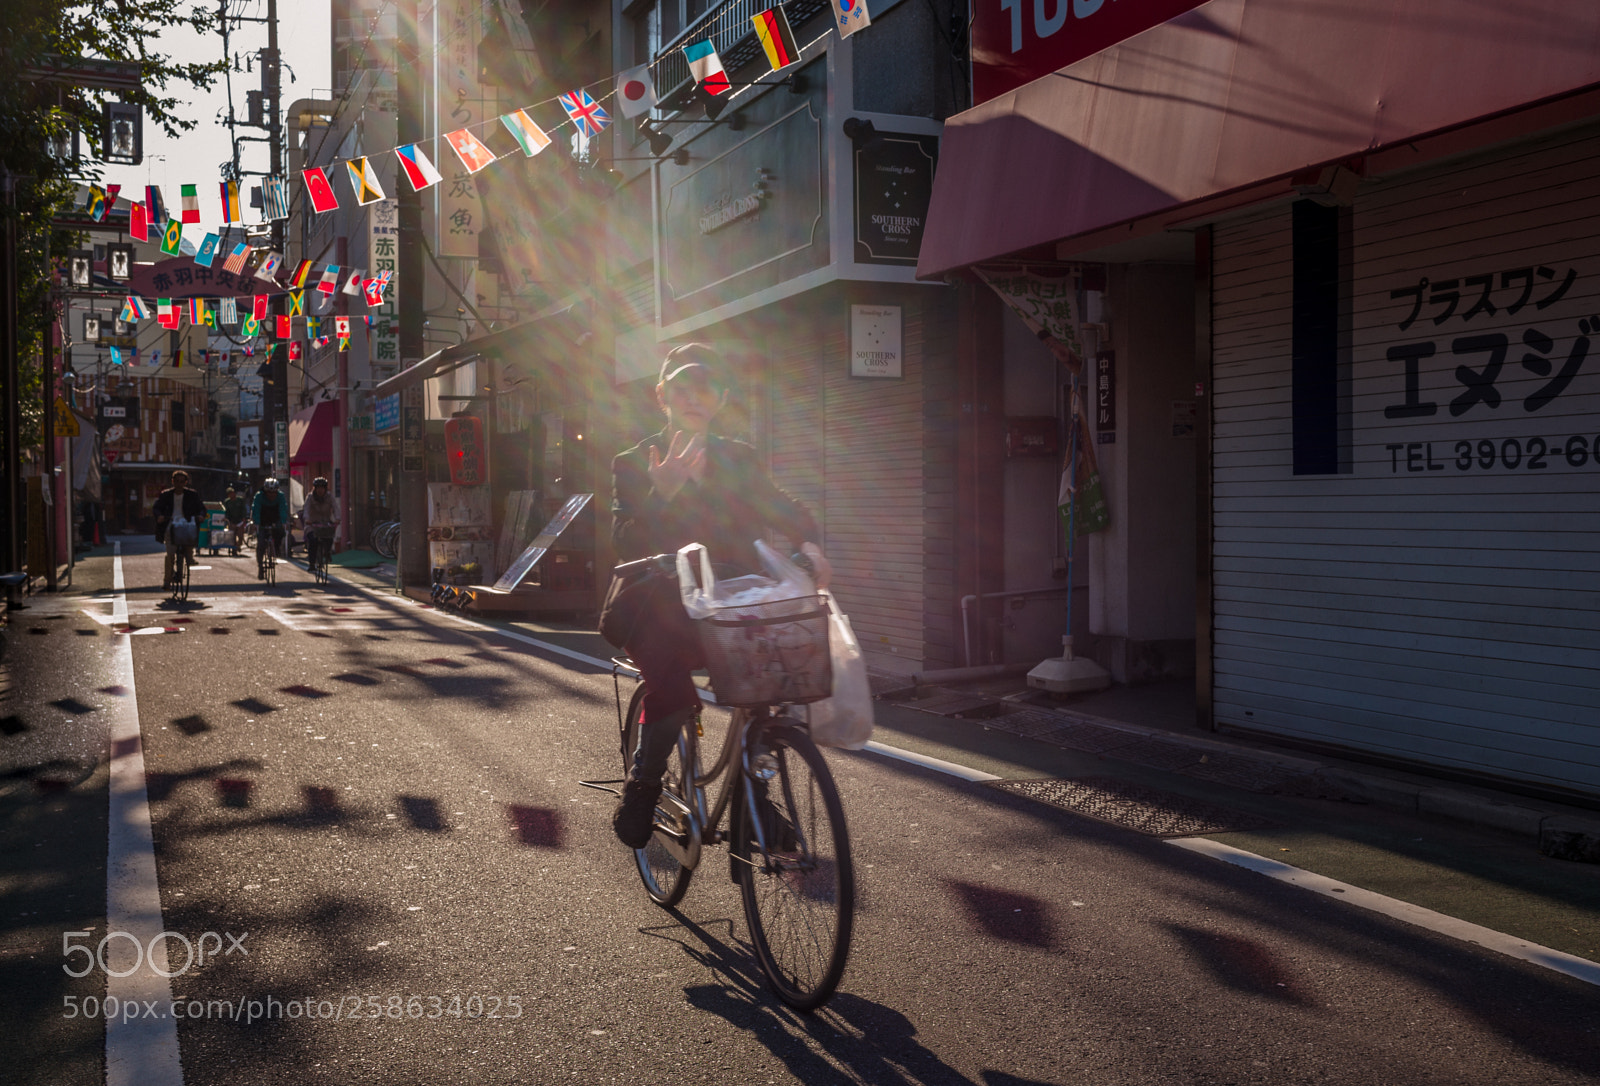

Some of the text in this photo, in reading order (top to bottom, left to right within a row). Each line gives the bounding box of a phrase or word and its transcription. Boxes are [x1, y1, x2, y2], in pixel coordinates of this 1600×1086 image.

[903, 166, 916, 174] Bar
[699, 207, 735, 235] SOUTHERN
[733, 194, 760, 217] CROSS
[871, 214, 920, 228] SOUTHERN
[881, 224, 911, 235] CROSS
[1390, 265, 1578, 332] プラスワン
[856, 351, 896, 360] SOUTHERN
[864, 359, 889, 367] CROSS
[1099, 357, 1110, 424] 中島ビル
[1386, 443, 1444, 473] TEL
